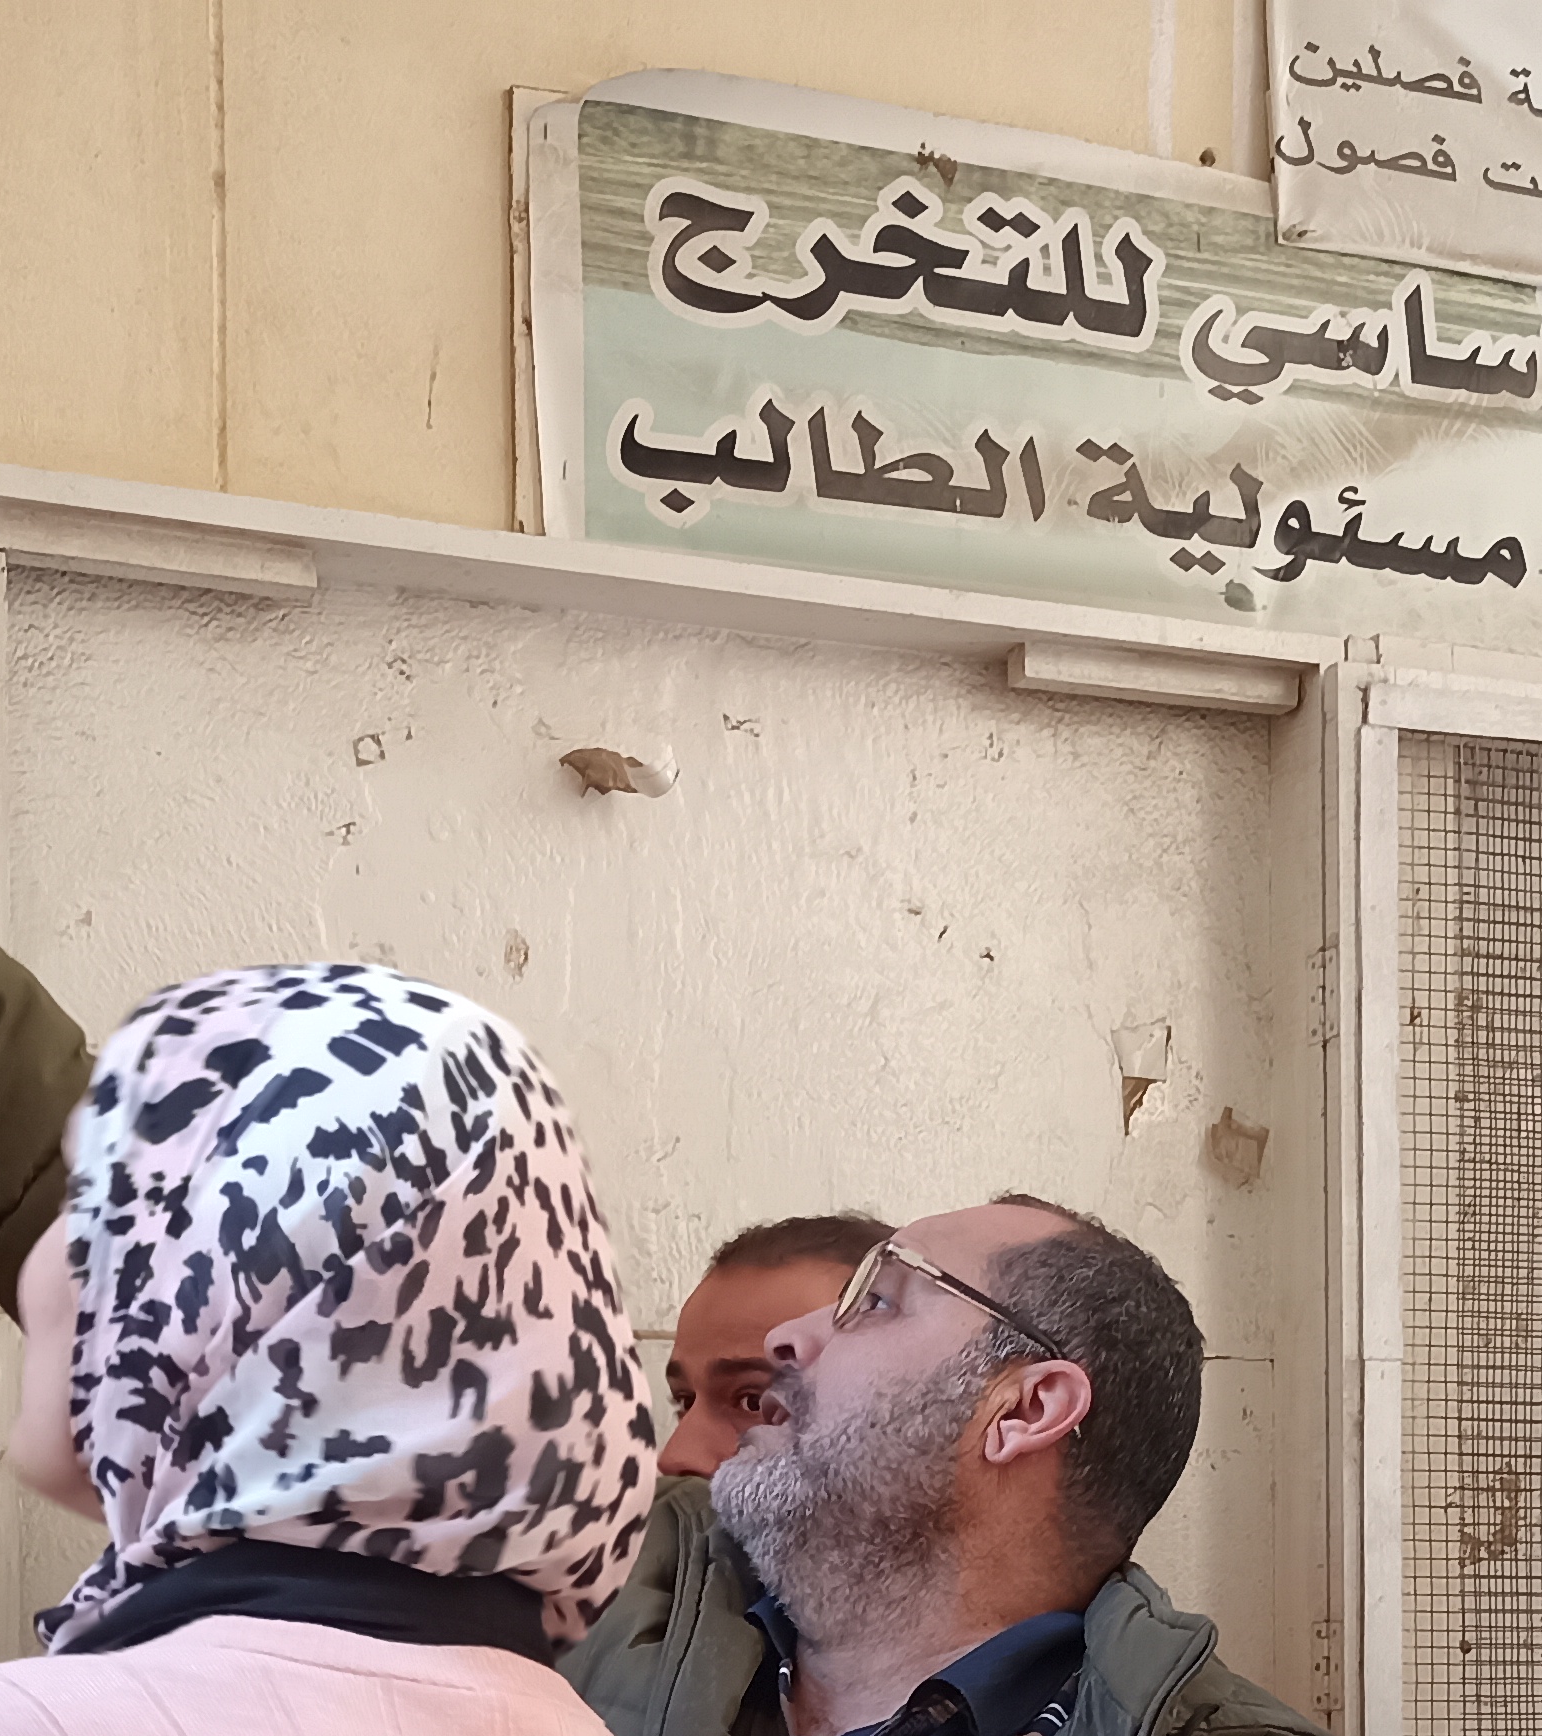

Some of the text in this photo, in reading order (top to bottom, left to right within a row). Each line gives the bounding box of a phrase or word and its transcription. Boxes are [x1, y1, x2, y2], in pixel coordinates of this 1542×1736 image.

[1289, 41, 1482, 104] فصلين
[1275, 116, 1457, 181] فصول
[658, 190, 1152, 337] للتخرج
[620, 399, 1045, 522] الطالب
[1075, 438, 1527, 587] مسئولية
